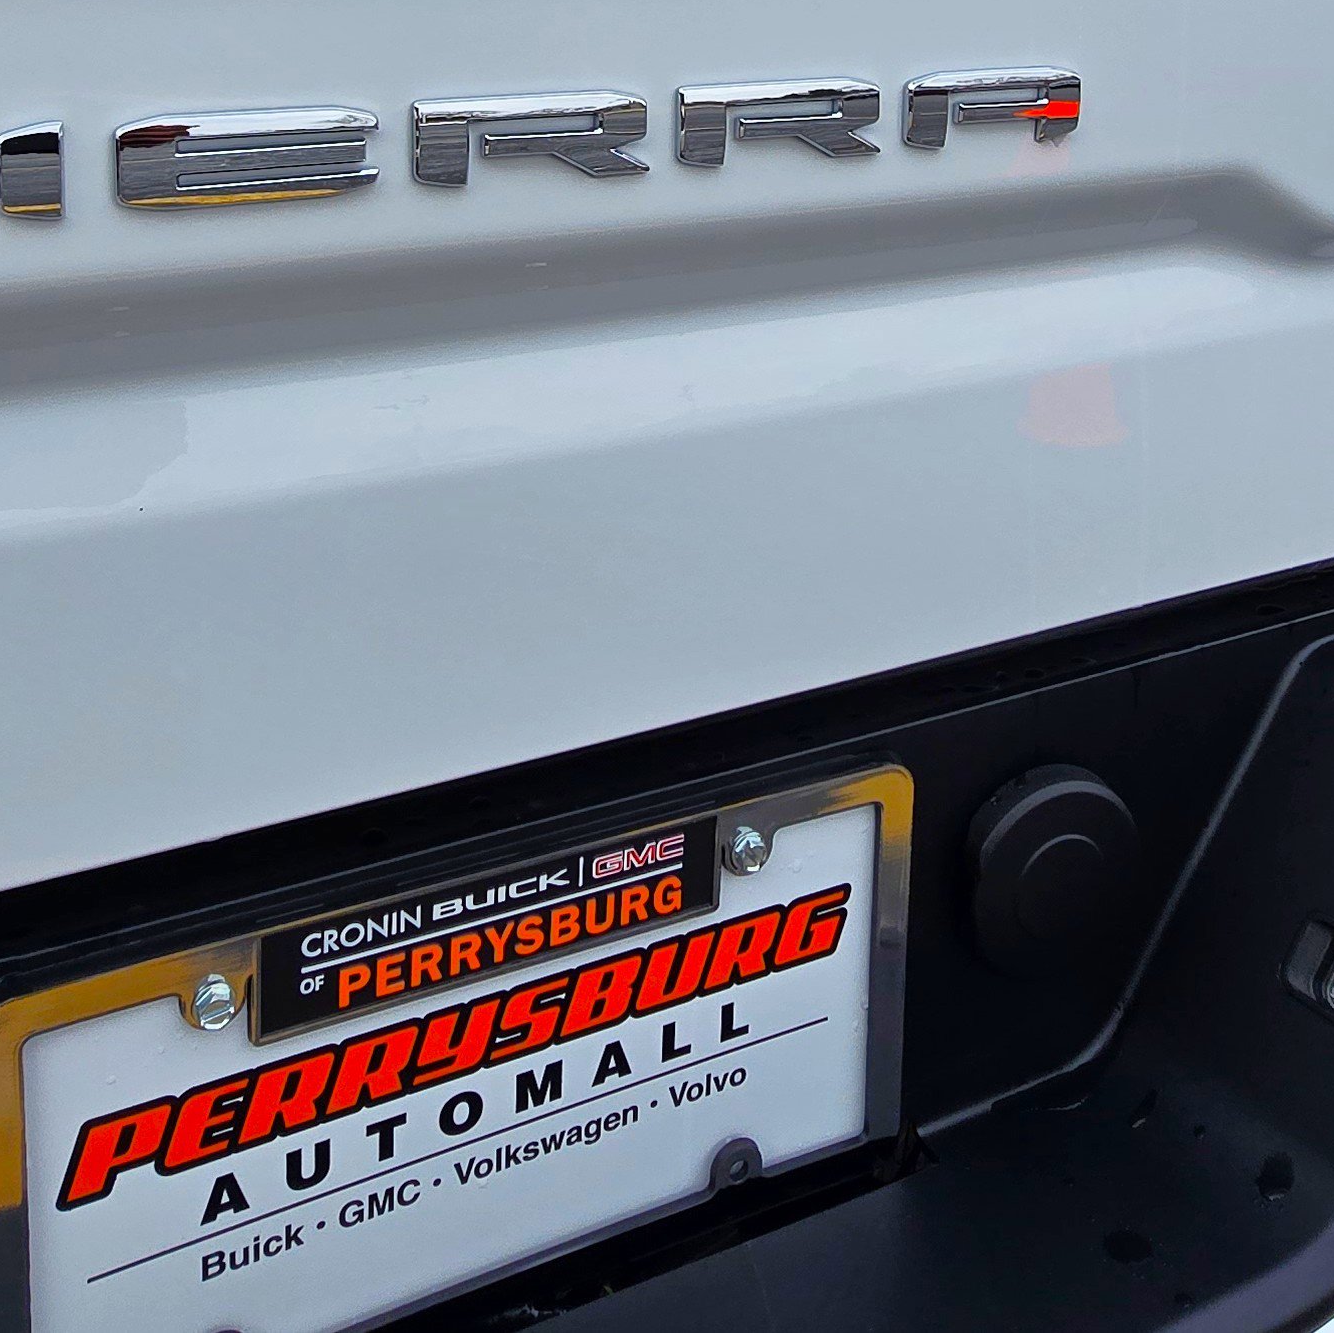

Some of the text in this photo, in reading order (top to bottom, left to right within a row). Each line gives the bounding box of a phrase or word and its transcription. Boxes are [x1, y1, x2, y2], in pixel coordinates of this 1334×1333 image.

[299, 874, 683, 1010] OF PERRYSBURG
[300, 833, 685, 959] CRONIN BUICK GMC
[56, 883, 852, 1211] PERRYSBURG
[200, 1002, 750, 1226] AUTOMALL
[201, 1067, 748, 1282] Buick GMC Volkswagen Volvo
